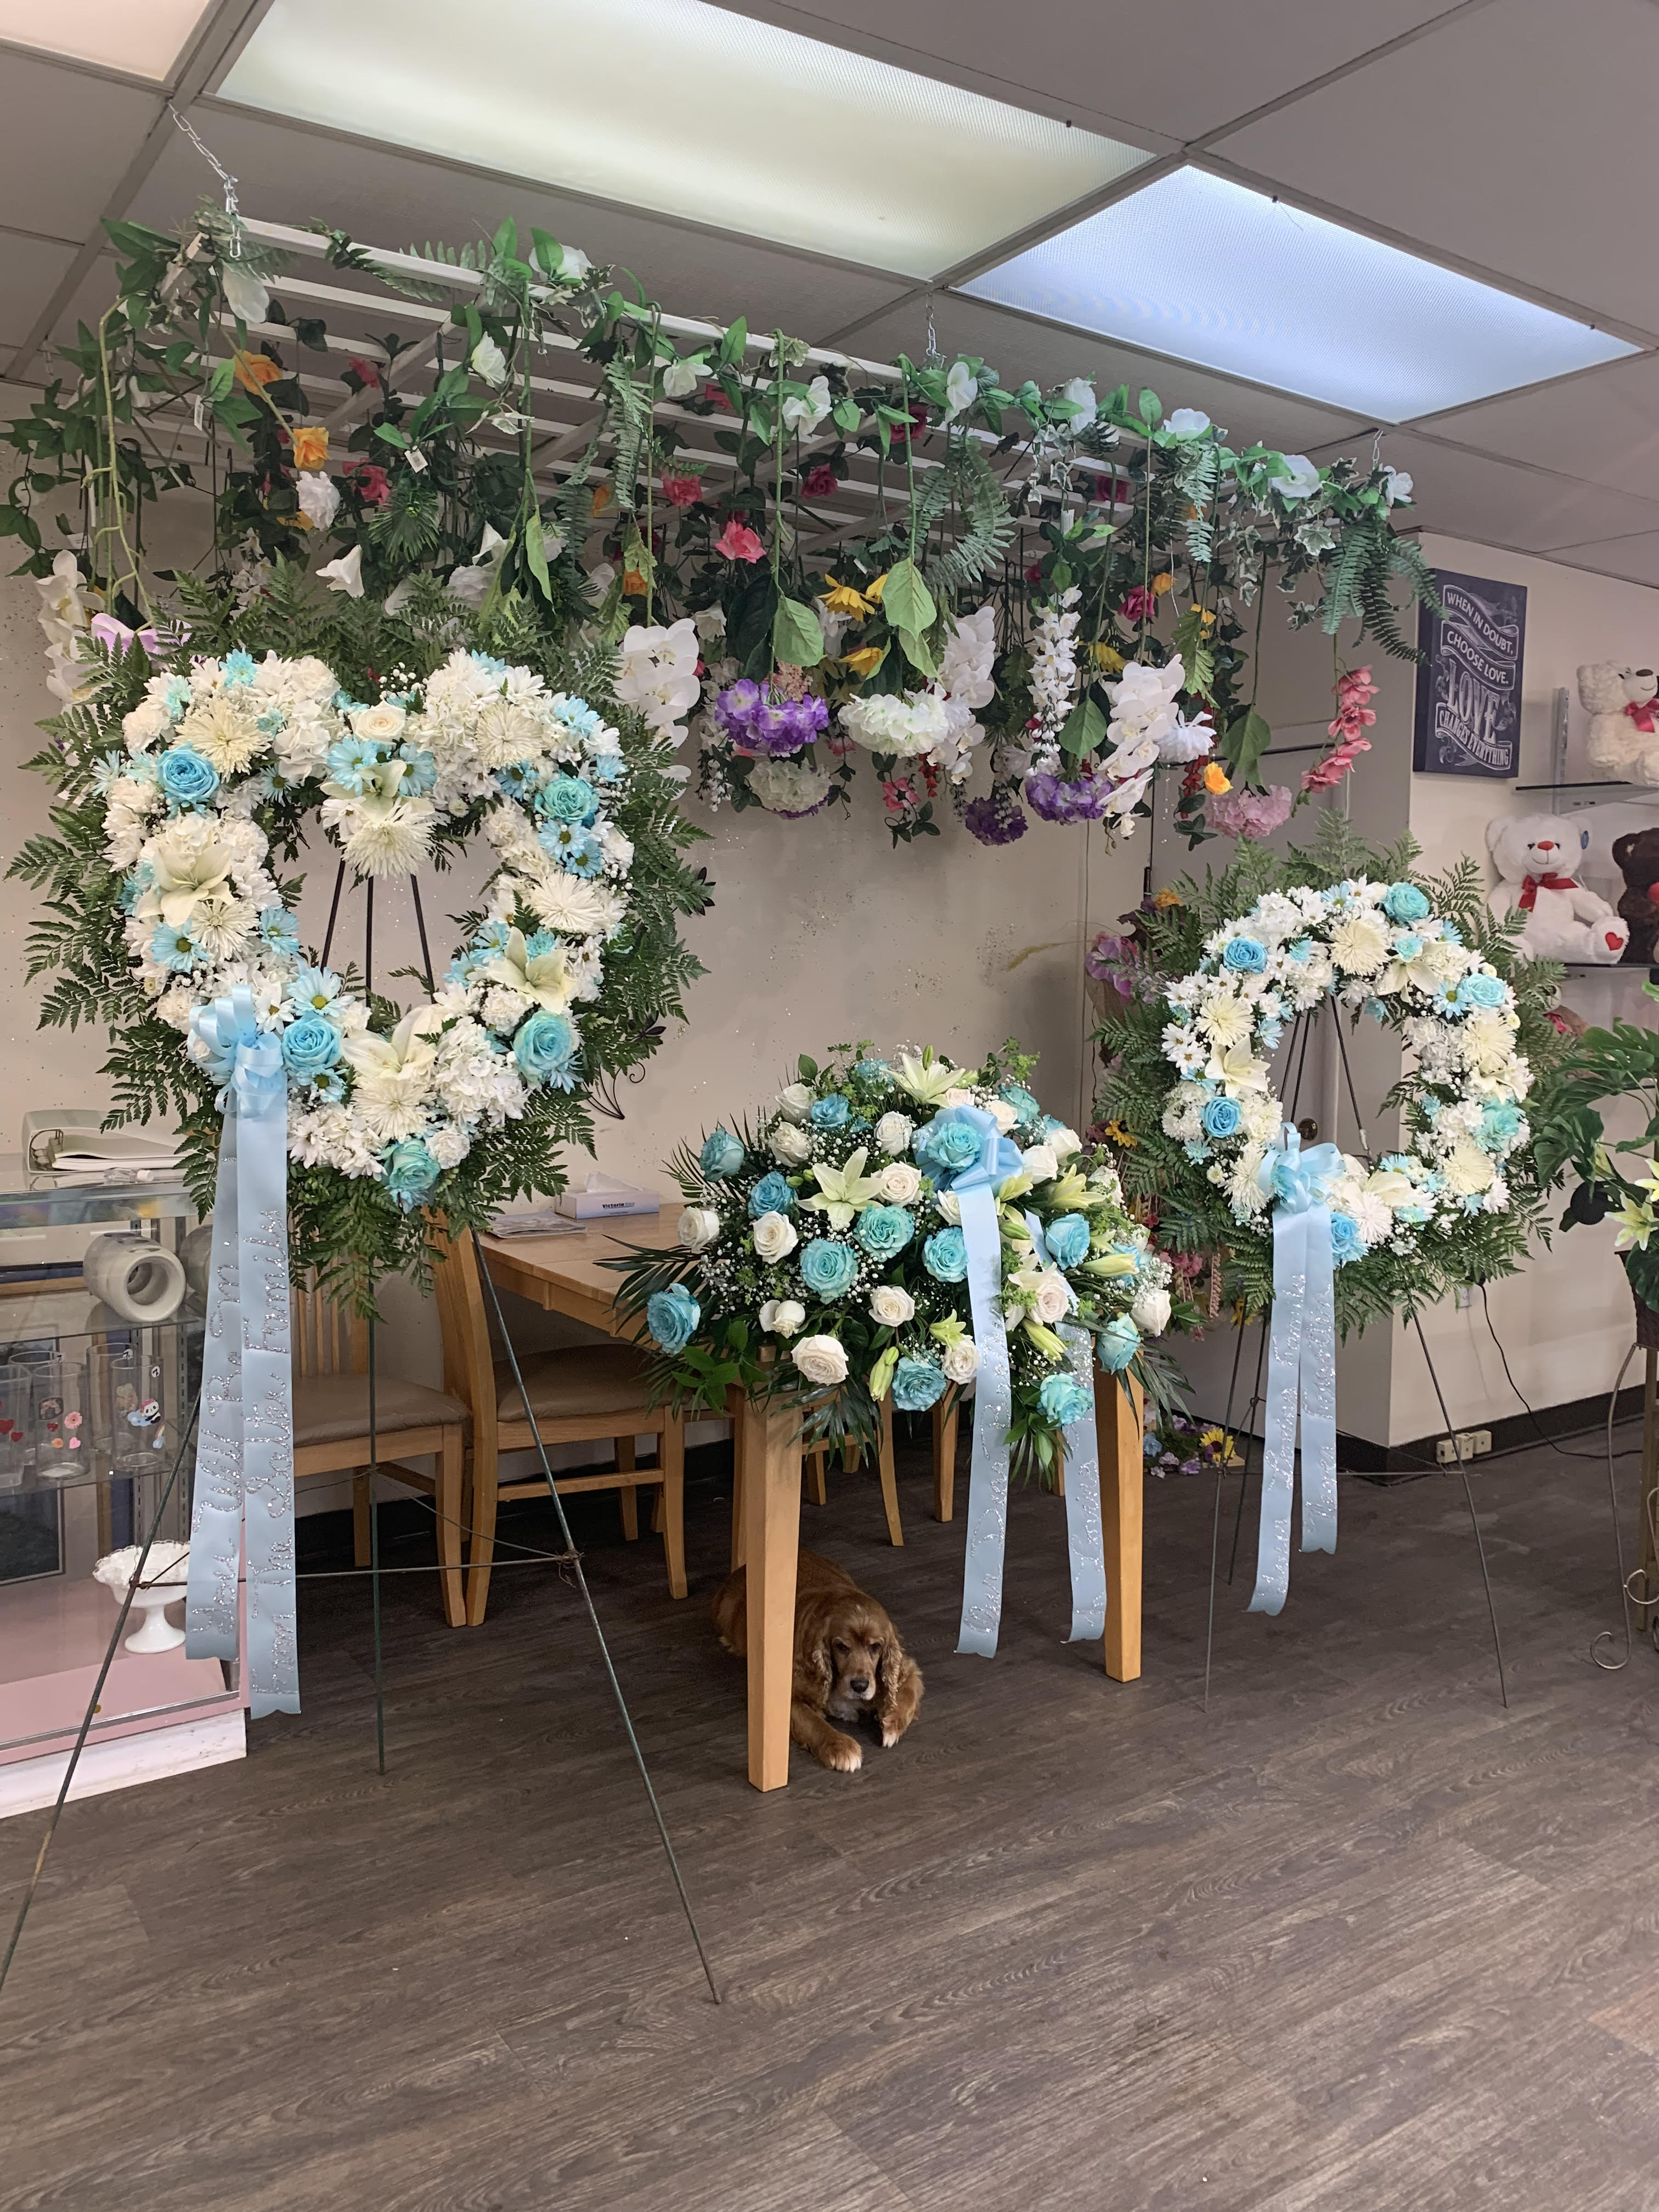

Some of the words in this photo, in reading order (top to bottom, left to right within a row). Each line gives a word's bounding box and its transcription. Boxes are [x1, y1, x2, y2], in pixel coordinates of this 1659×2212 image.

[1447, 592, 1474, 617] WHEN
[1473, 612, 1483, 629] IN
[1447, 631, 1485, 672] CHOOSE
[1484, 664, 1509, 684] LOVE.
[1447, 658, 1500, 745] LOVE
[1439, 710, 1470, 745] CHANGES
[1467, 733, 1509, 766] EVERYTHING
[244, 1210, 289, 1353] Family
[1272, 1274, 1306, 1367] Family
[192, 1429, 243, 1532] Will
[1265, 1388, 1300, 1491] Loving
[970, 1450, 1008, 1557] Dear
[1071, 1458, 1104, 1581] Loving
[190, 1537, 236, 1634] You
[247, 1526, 294, 1618] The
[964, 1562, 1002, 1633] Our
[252, 1610, 298, 1694] From
